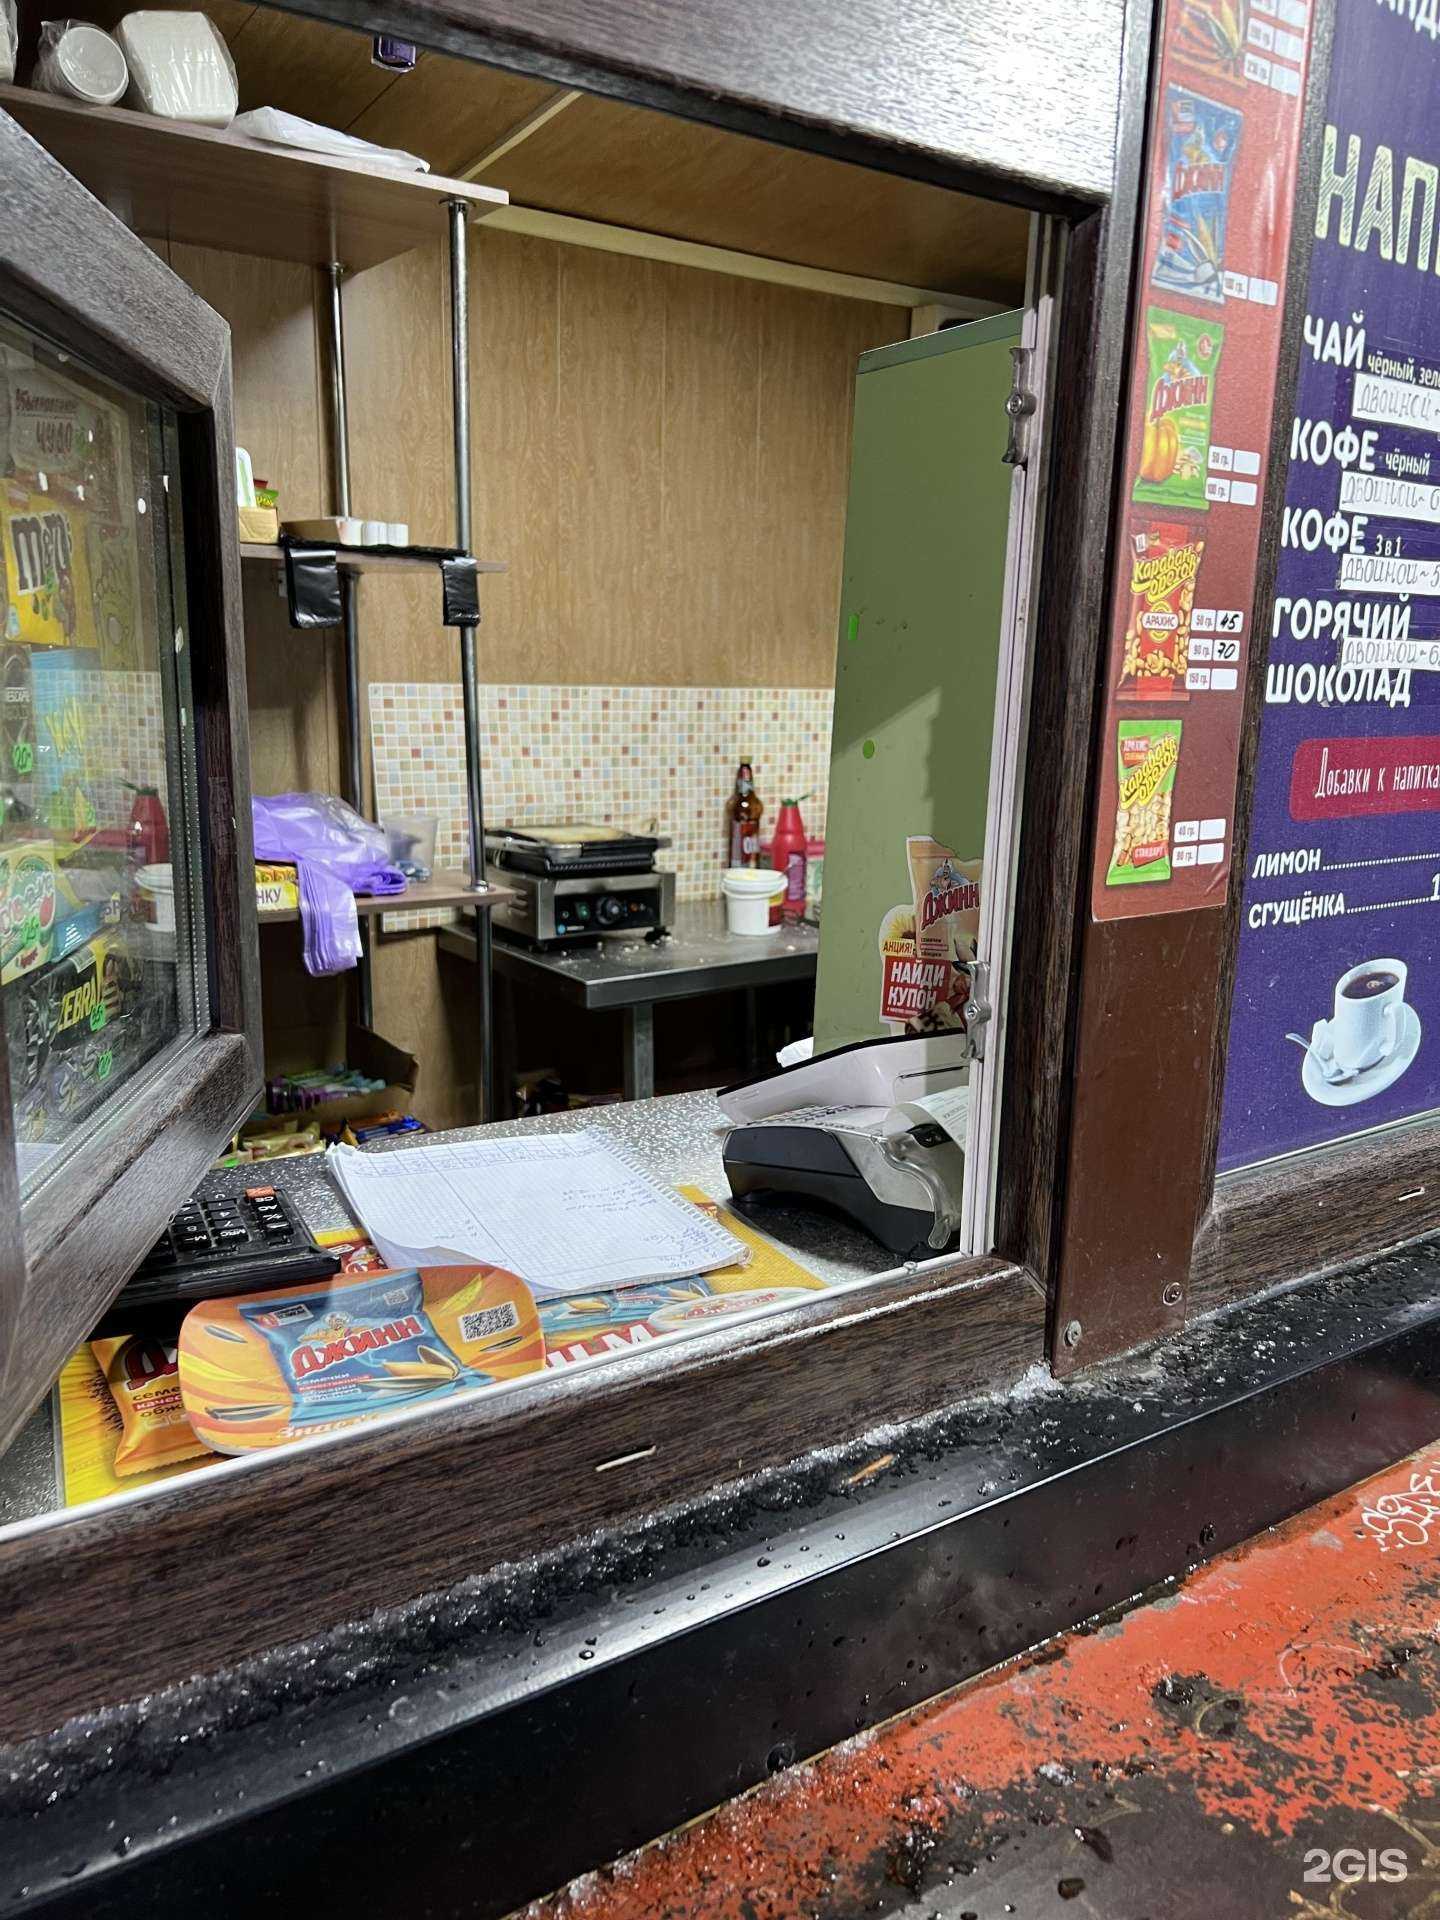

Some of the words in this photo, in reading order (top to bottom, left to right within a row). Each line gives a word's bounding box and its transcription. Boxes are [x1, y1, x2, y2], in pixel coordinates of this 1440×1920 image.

[1315, 124, 1440, 277] НАП
[1304, 310, 1366, 370] ЧАЙ
[1367, 351, 1416, 385] чёрный,
[1290, 417, 1379, 472] КОФЕ
[1385, 447, 1431, 477] чёрный
[1281, 506, 1369, 554] КОФЕ
[1144, 615, 1177, 627] АРАХИС
[1272, 593, 1411, 640] ГОРЯЧИЙ
[1265, 663, 1412, 708] ШОКОЛАД
[1314, 747, 1372, 798] Добавки
[1377, 767, 1386, 792] к
[1392, 763, 1440, 791] напитка
[1251, 848, 1322, 879] ЛИМОН
[1248, 890, 1346, 929] СГУЩЁНКА
[887, 985, 938, 1010] КУПОН
[890, 960, 946, 988] НАЙДИ
[290, 1315, 424, 1380] ДЖИНН
